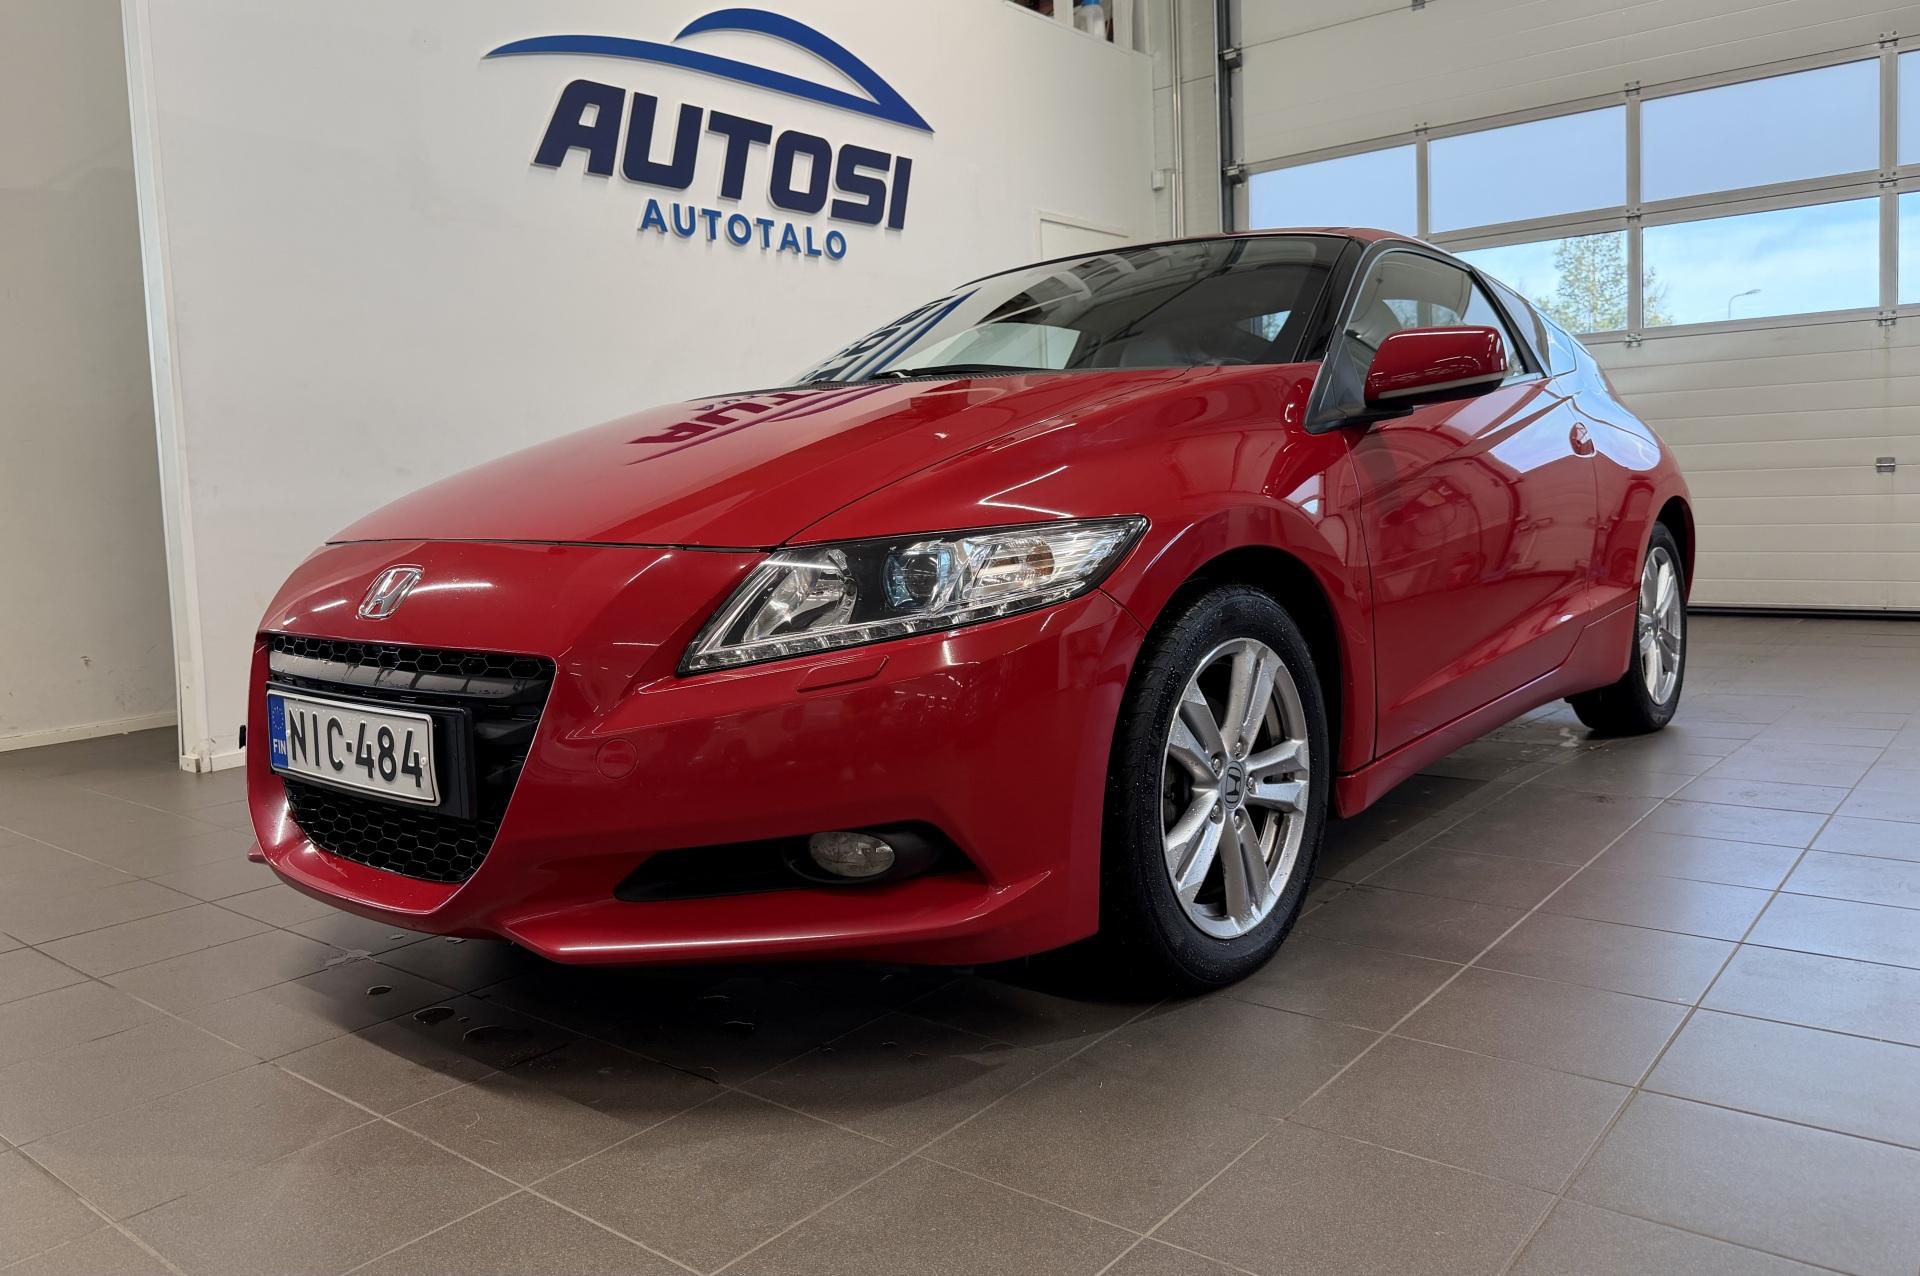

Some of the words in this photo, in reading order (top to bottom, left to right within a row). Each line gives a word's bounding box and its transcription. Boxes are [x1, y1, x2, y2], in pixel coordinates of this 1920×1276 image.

[530, 79, 913, 230] AUTOSI
[639, 198, 847, 260] AUTOTALO
[272, 738, 287, 756] FIN
[288, 709, 424, 788] NIC-484
